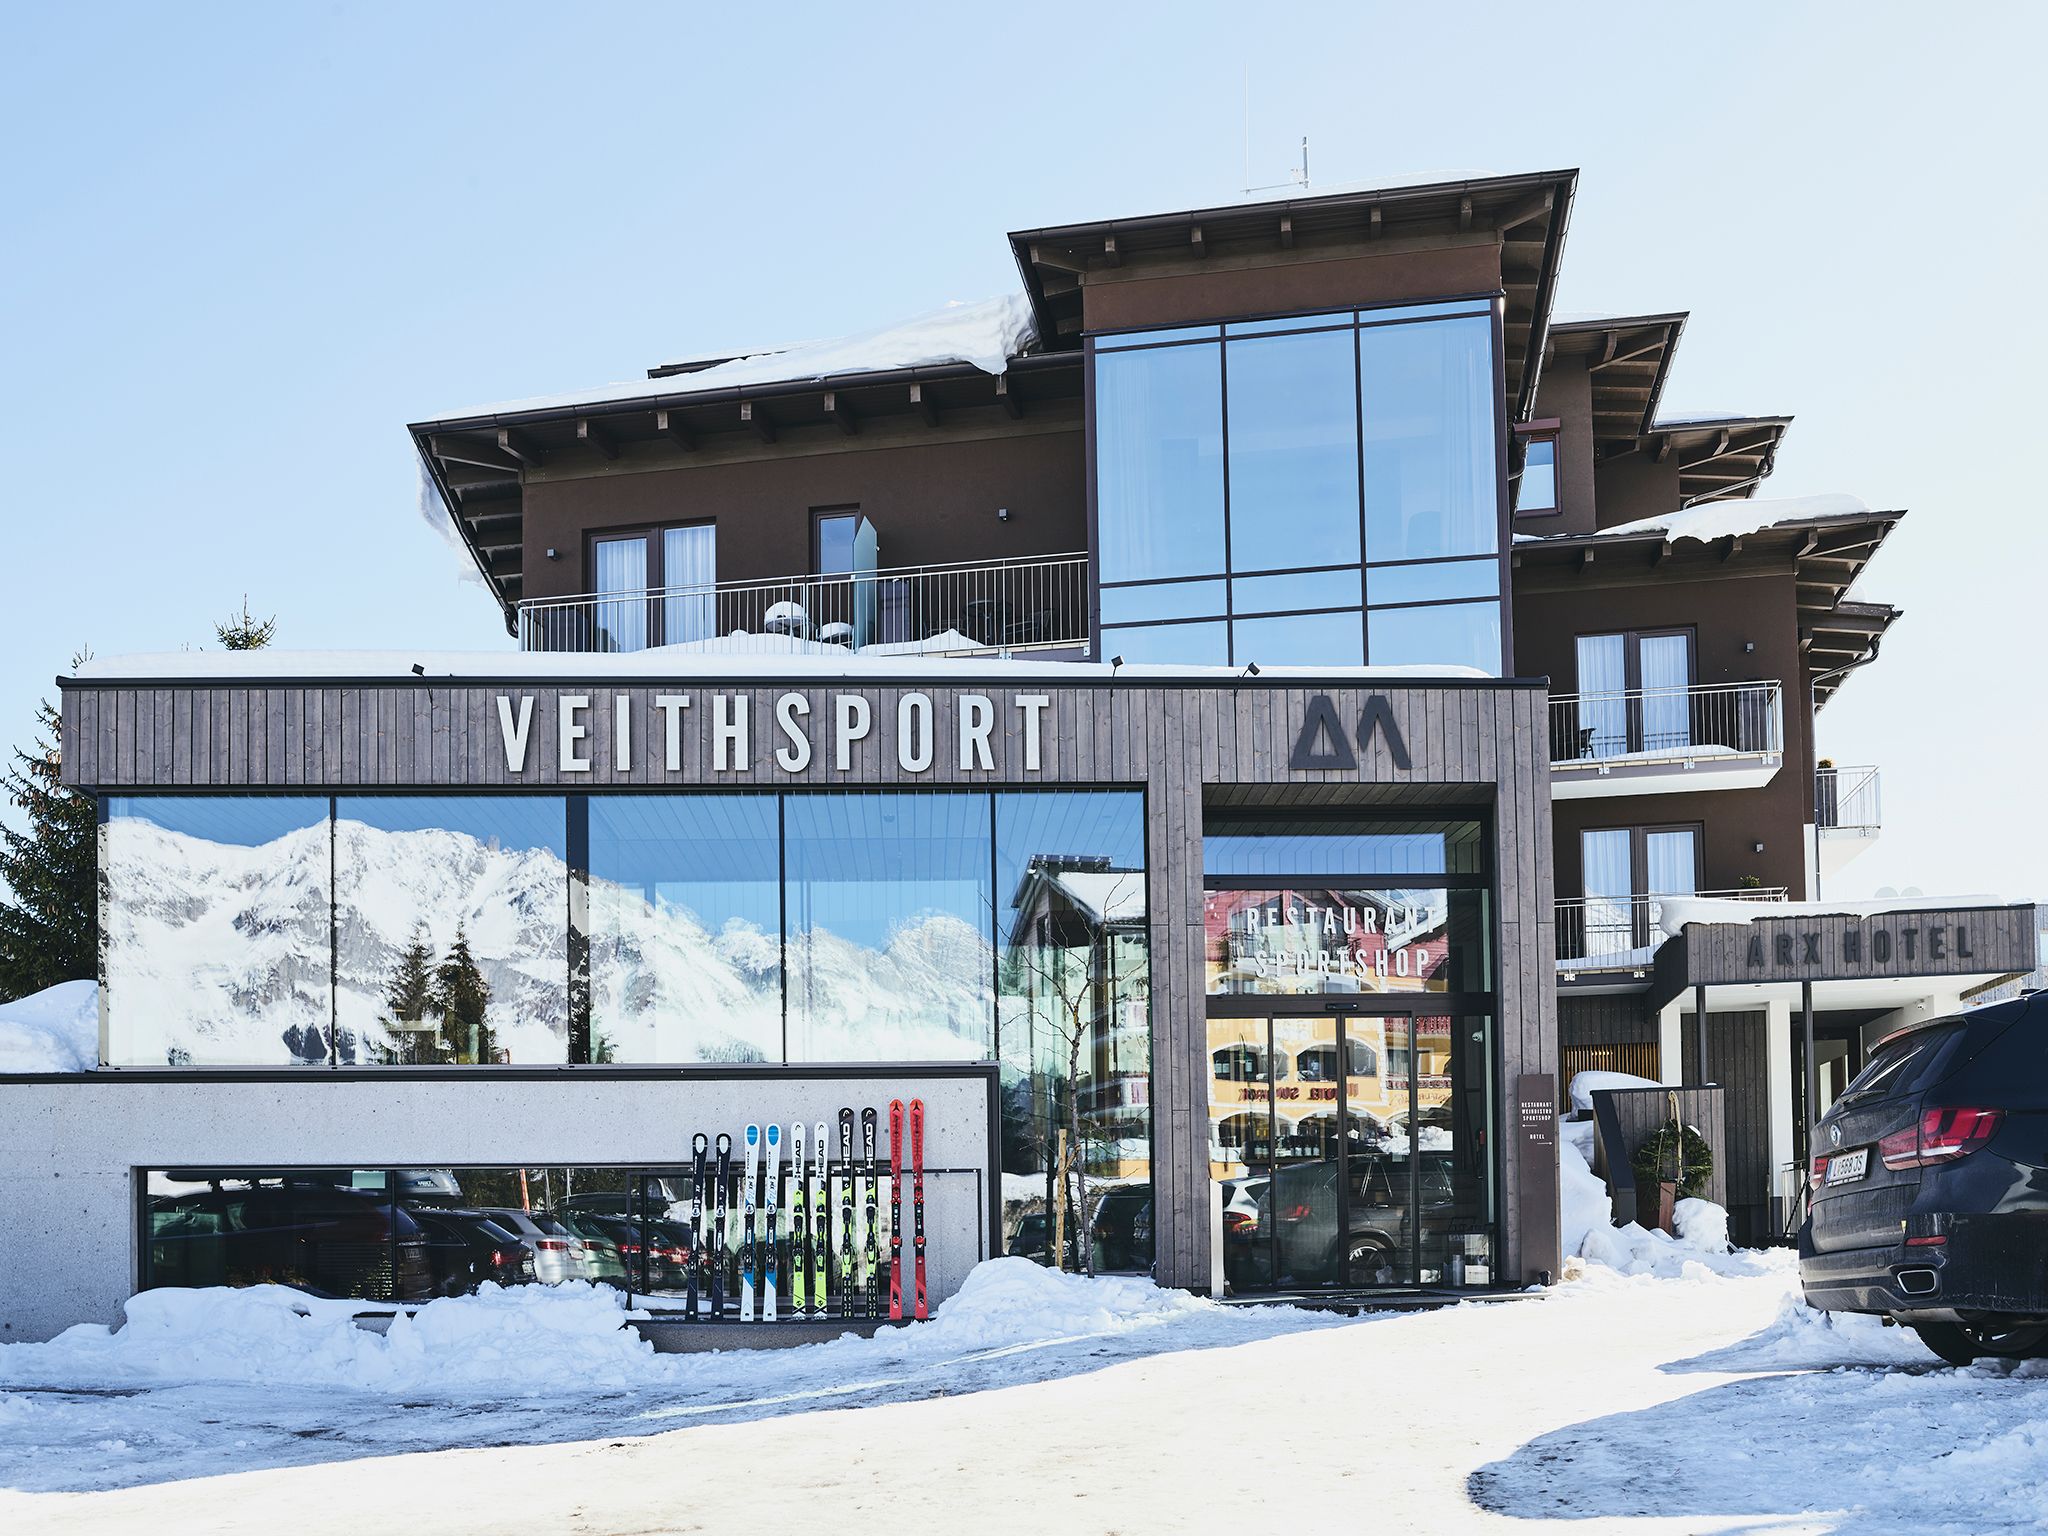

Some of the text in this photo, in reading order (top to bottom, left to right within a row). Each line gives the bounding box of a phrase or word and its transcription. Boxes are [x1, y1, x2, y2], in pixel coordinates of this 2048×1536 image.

[496, 692, 1050, 773] VEITHSPORT
[1247, 906, 1437, 935] RESTAURANT
[1254, 949, 1430, 977] SPORTSHOP
[1747, 926, 1973, 967] ARX HOTEL
